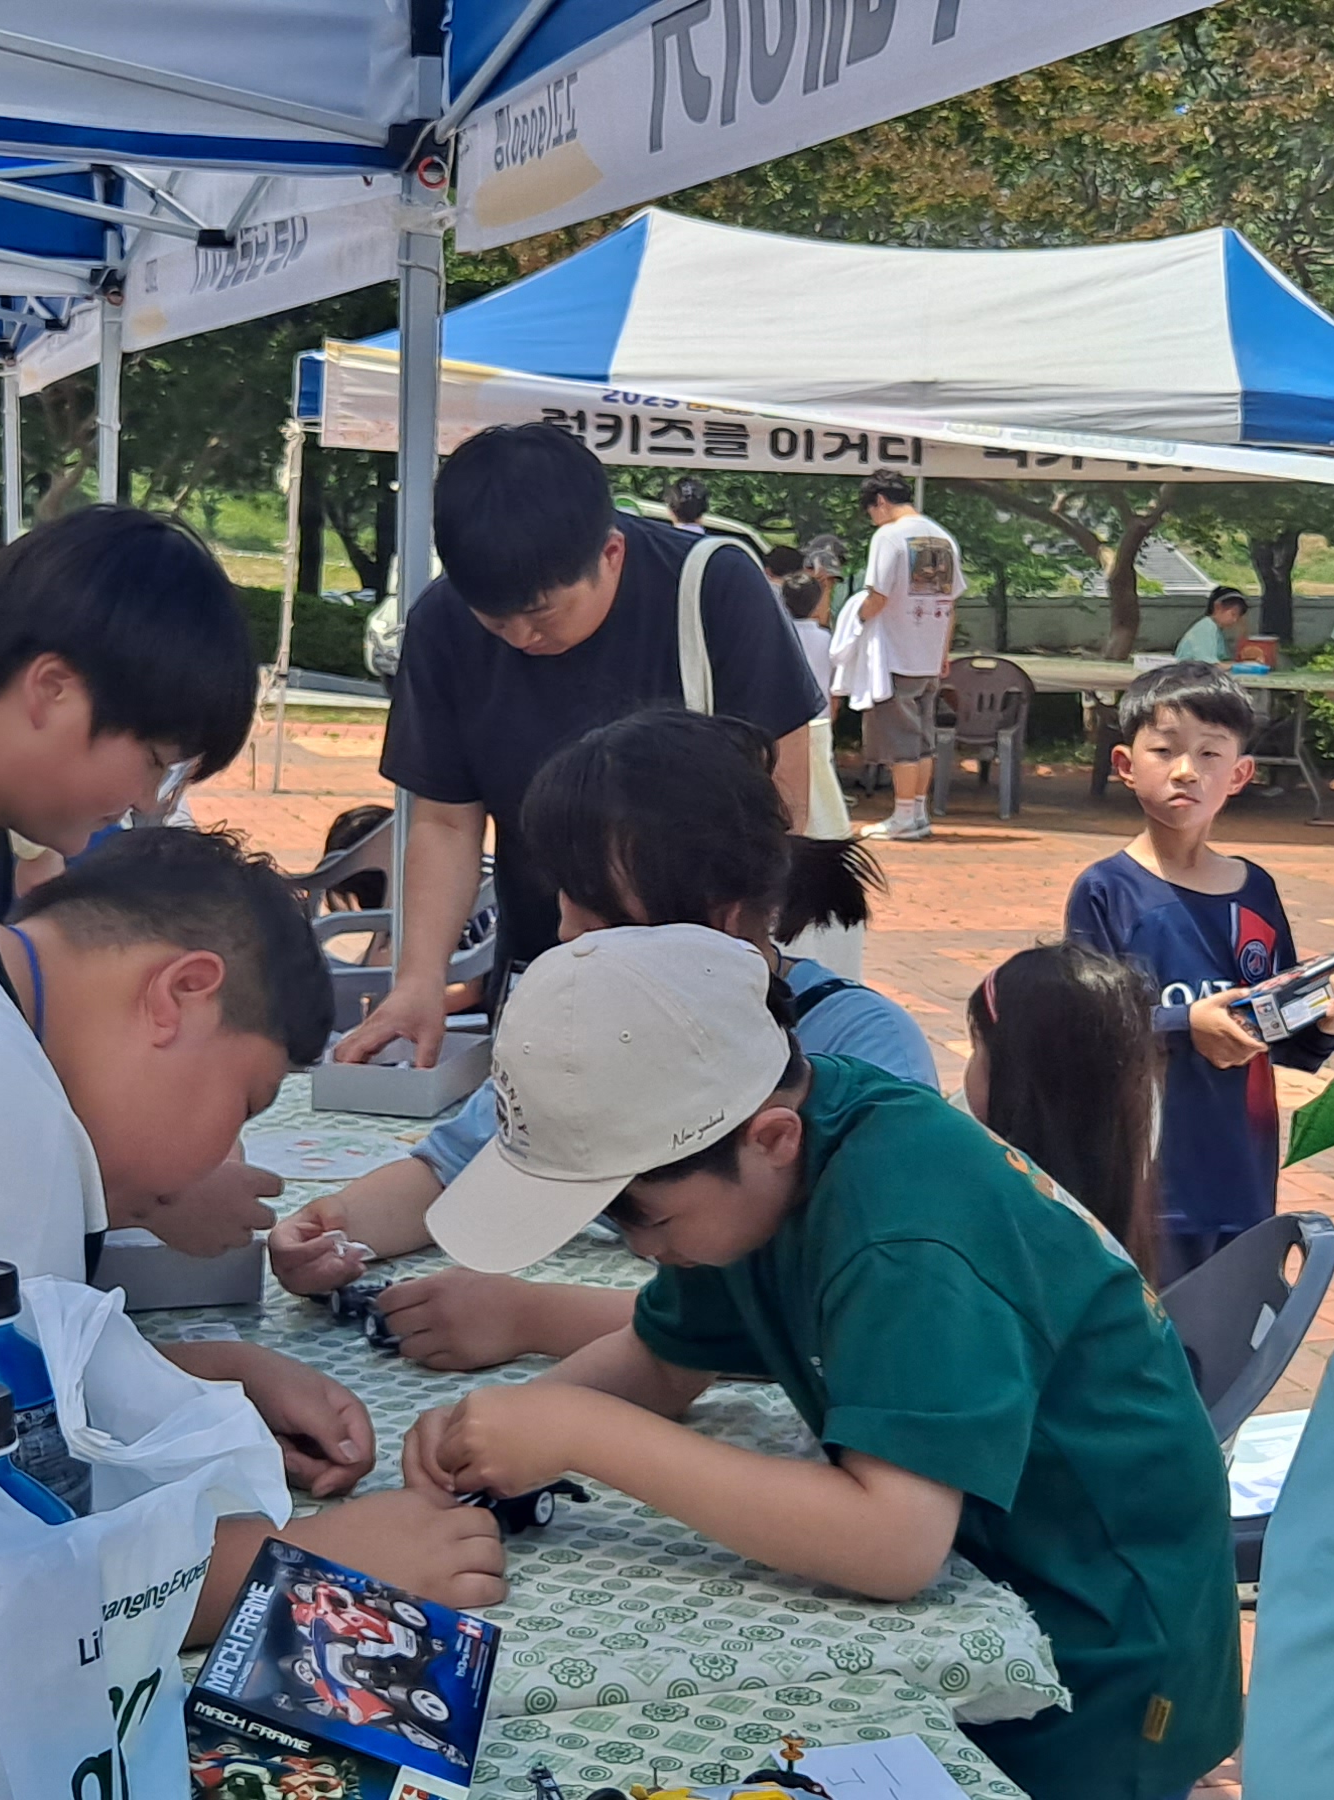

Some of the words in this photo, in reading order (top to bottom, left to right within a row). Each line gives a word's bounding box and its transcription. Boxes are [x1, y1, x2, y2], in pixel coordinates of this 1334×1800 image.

[203, 1636, 246, 1694] MACH
[229, 1580, 275, 1648] FRAME
[194, 1701, 246, 1730] MACH
[247, 1721, 312, 1754] FRAME
